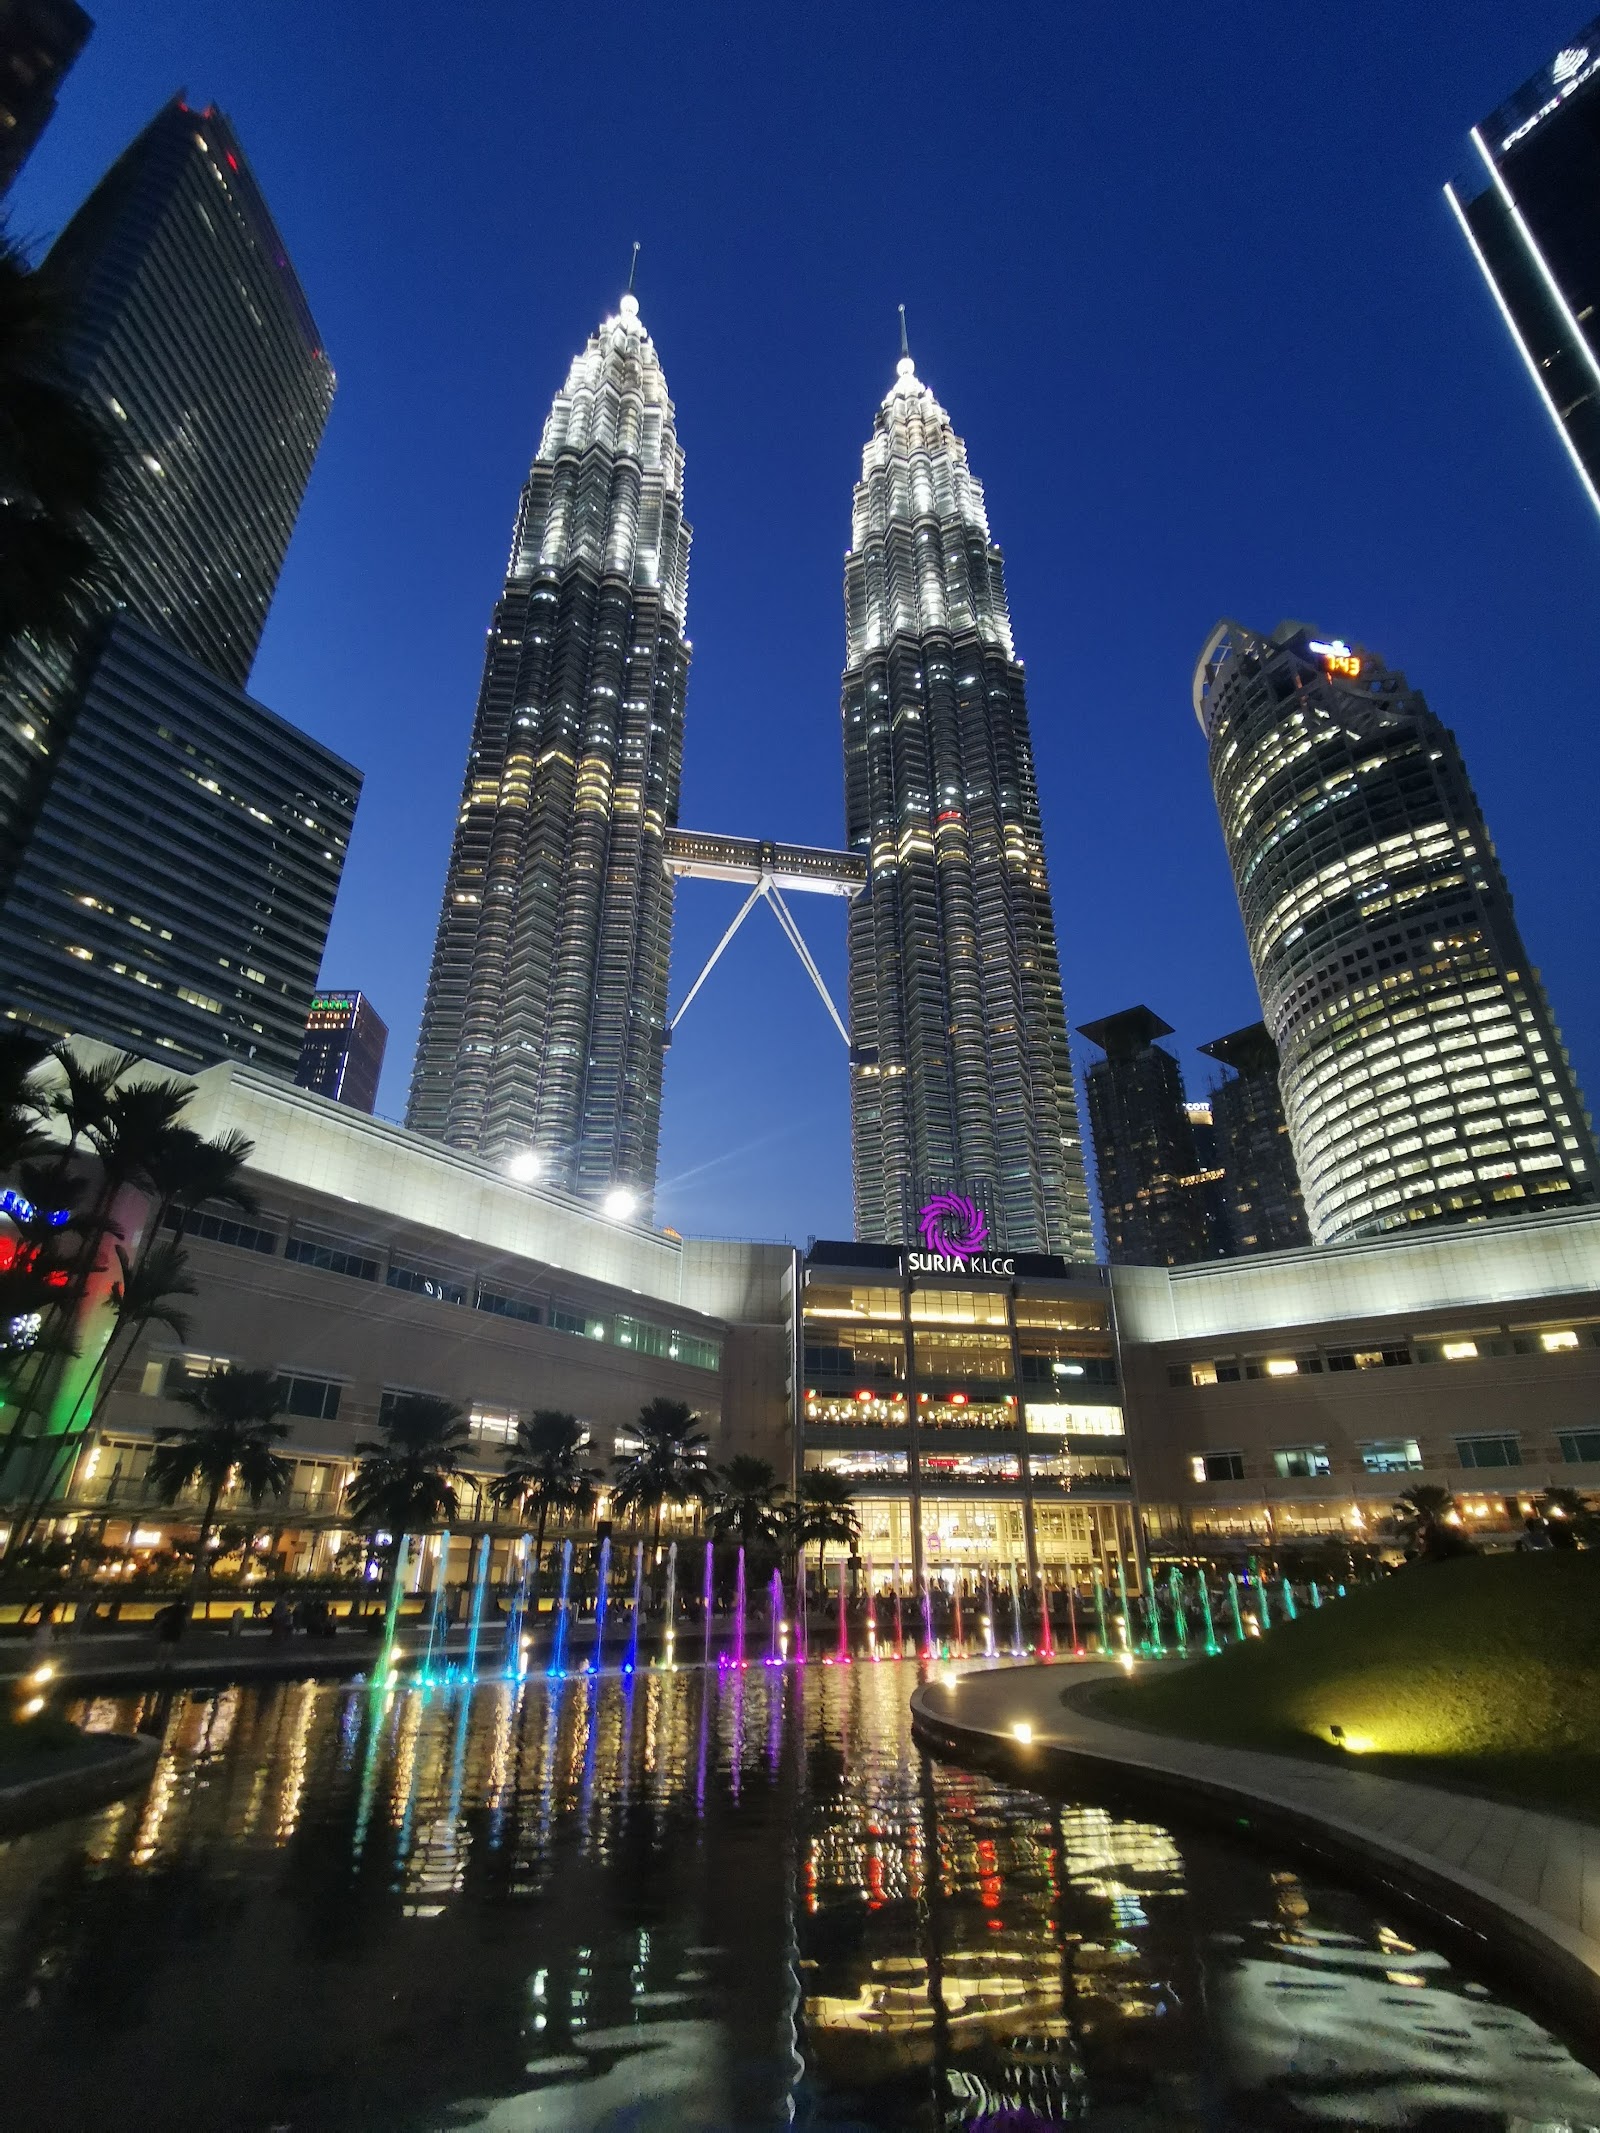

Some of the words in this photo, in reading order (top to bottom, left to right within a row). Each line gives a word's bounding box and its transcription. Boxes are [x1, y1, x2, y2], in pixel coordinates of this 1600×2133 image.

[1182, 1102, 1210, 1111] COTT
[908, 1252, 966, 1273] SURIA
[971, 1257, 1016, 1275] KLCC
